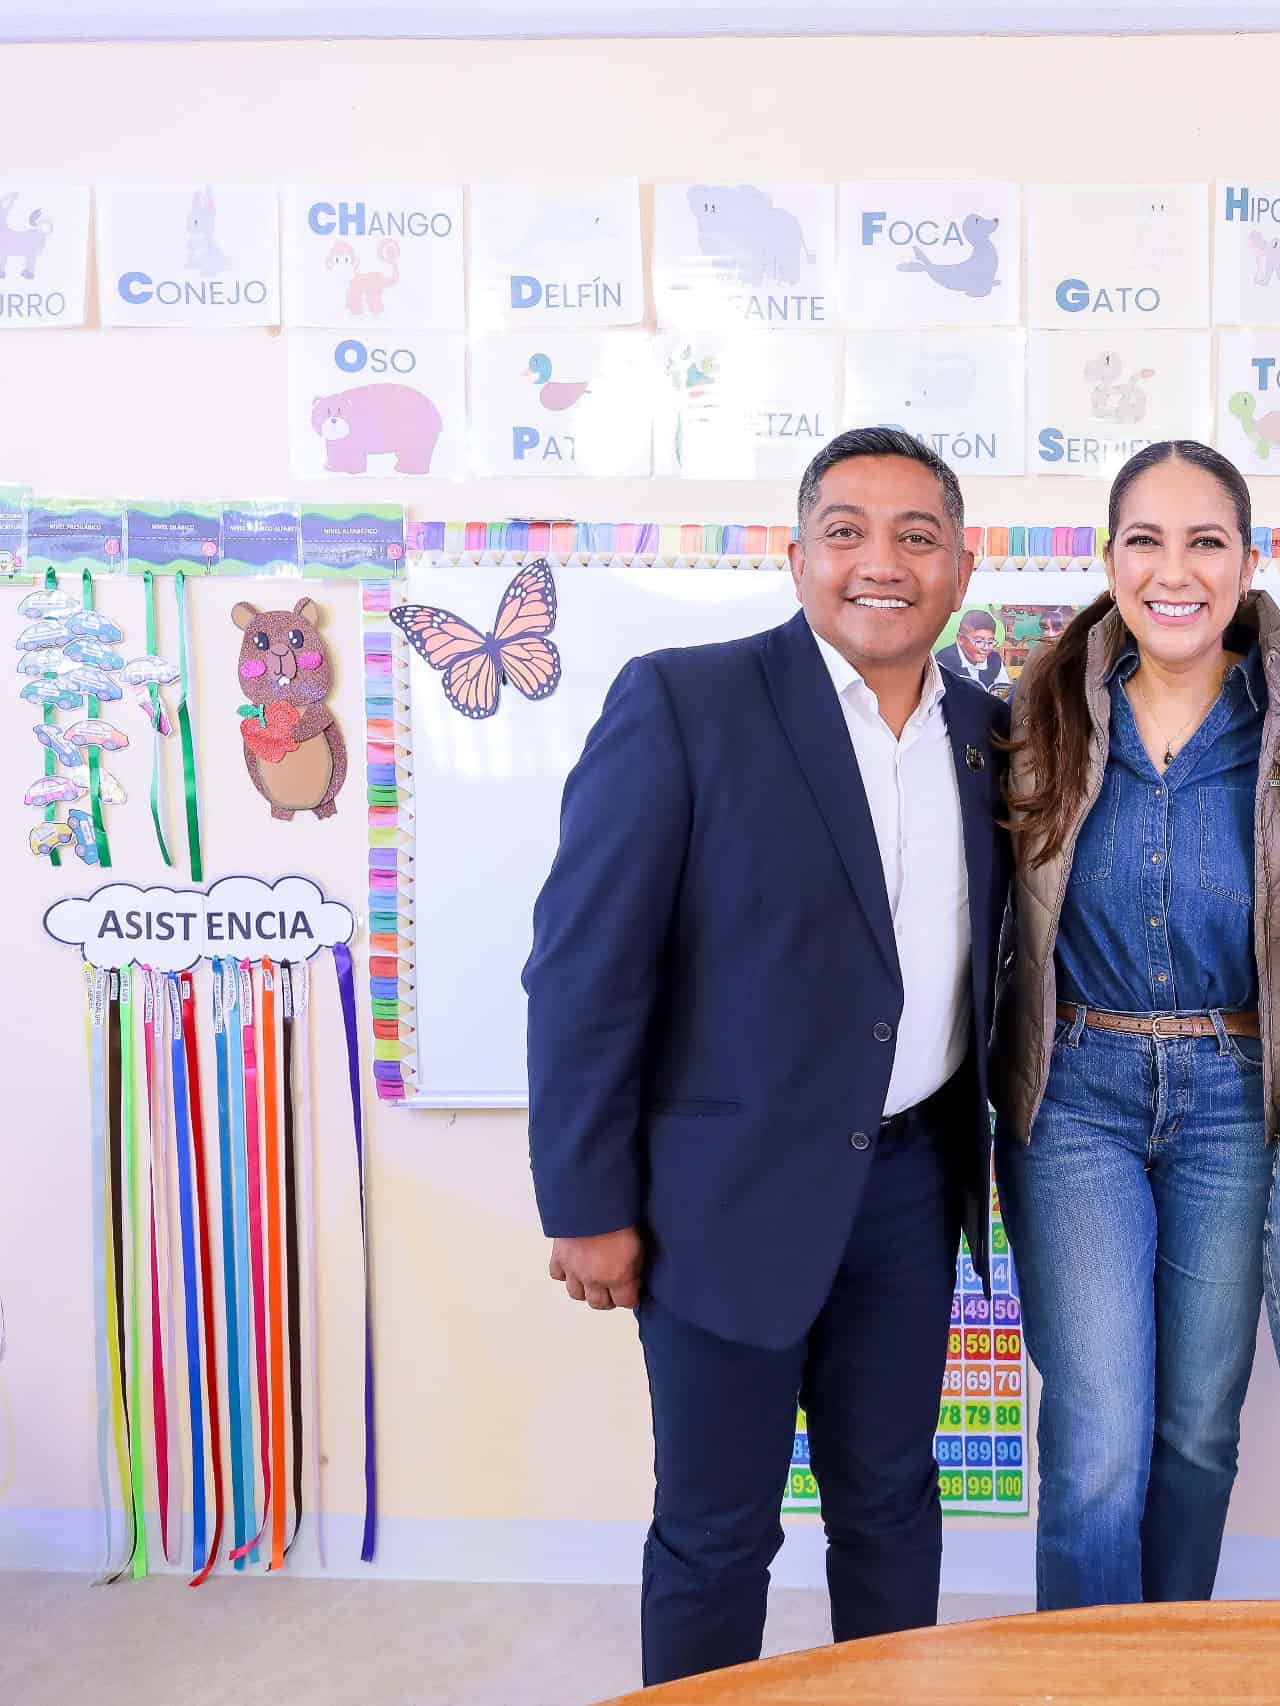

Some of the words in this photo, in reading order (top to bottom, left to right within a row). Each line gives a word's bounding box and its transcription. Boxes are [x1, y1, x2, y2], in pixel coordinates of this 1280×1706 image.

[307, 201, 452, 238] CHANGO
[861, 211, 963, 247] FOCA
[117, 271, 267, 305] CONEJO
[509, 275, 622, 309] DELFÍN
[1055, 278, 1161, 313] GATO
[334, 339, 417, 374] OSO
[512, 426, 576, 461] PAT
[964, 1300, 990, 1319] 49
[994, 1300, 1019, 1319] 50
[966, 1333, 990, 1353] 59
[995, 1334, 1020, 1354] 60
[966, 1370, 990, 1389] 69
[996, 1370, 1020, 1389] 70
[967, 1405, 990, 1425] 79
[995, 1406, 1020, 1425] 80
[937, 1441, 962, 1460] 88
[967, 1441, 991, 1460] 89
[997, 1441, 1021, 1461] 90
[793, 1474, 816, 1493] 93
[939, 1477, 962, 1496] 98
[967, 1477, 991, 1497] 99
[997, 1476, 1021, 1497] 100
